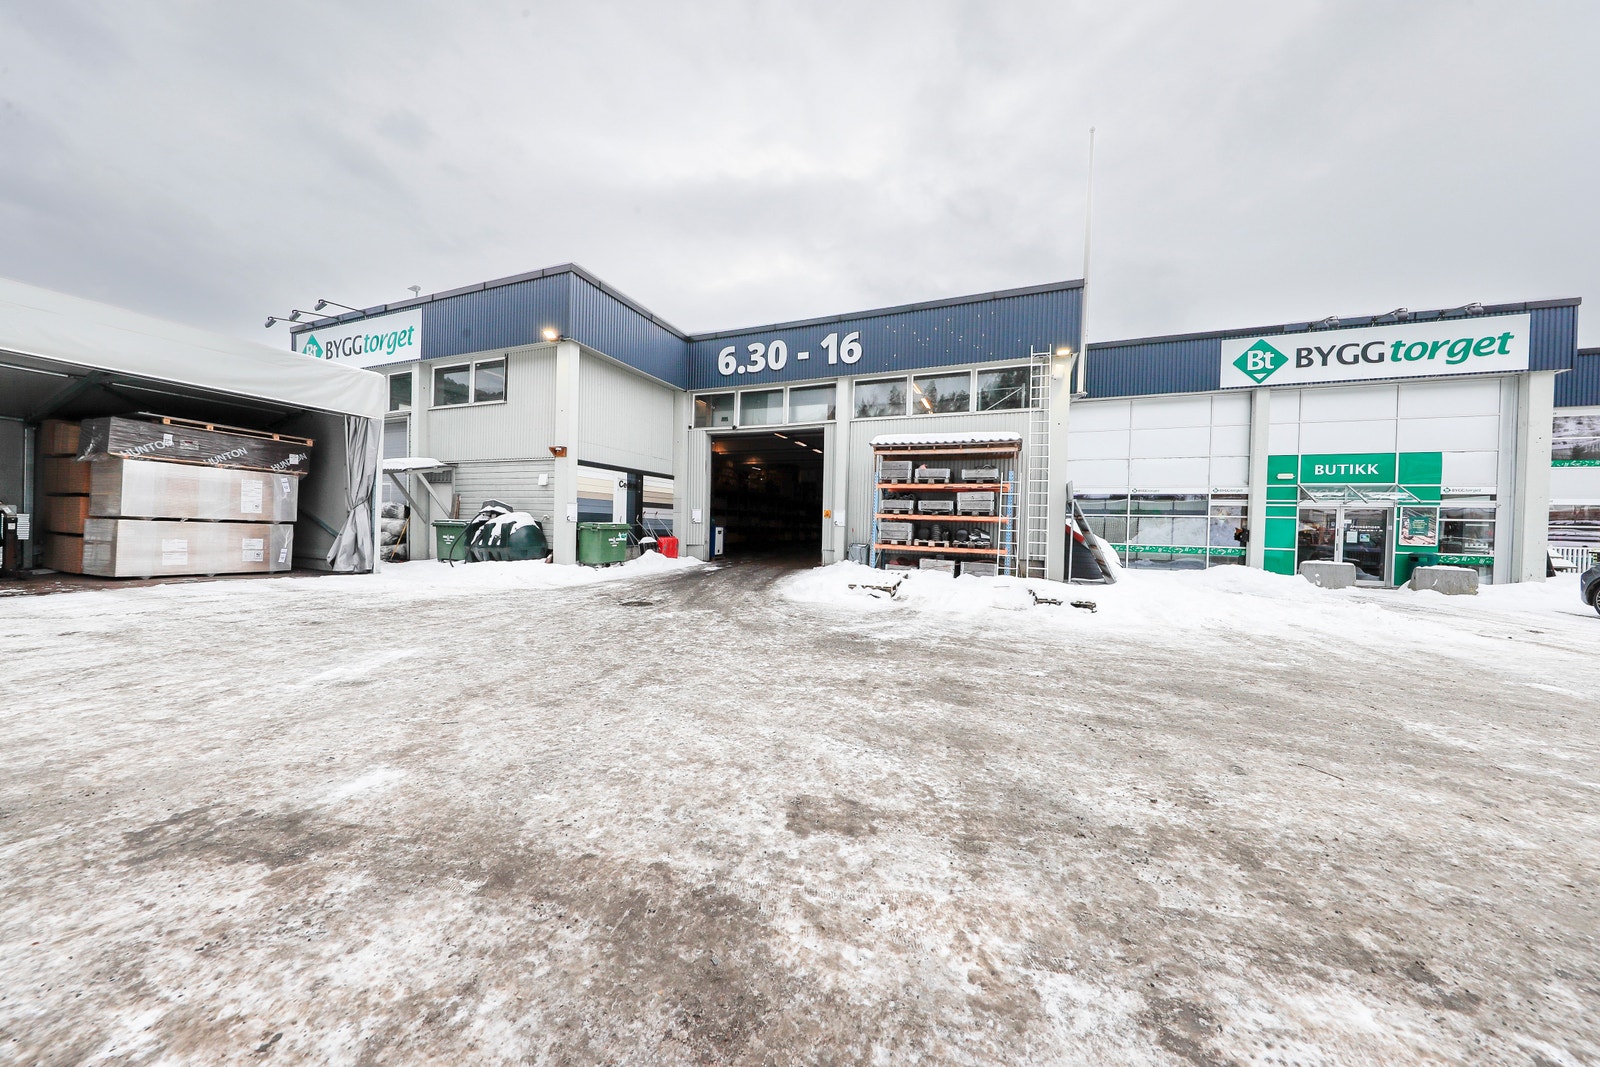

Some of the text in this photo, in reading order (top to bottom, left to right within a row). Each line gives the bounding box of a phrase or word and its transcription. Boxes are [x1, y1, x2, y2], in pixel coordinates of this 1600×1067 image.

[717, 339, 788, 376] 6.30
[820, 331, 863, 365] 16
[1247, 350, 1275, 371] Bt
[119, 440, 174, 457] HUNTO
[1314, 463, 1379, 476] BUTIKK
